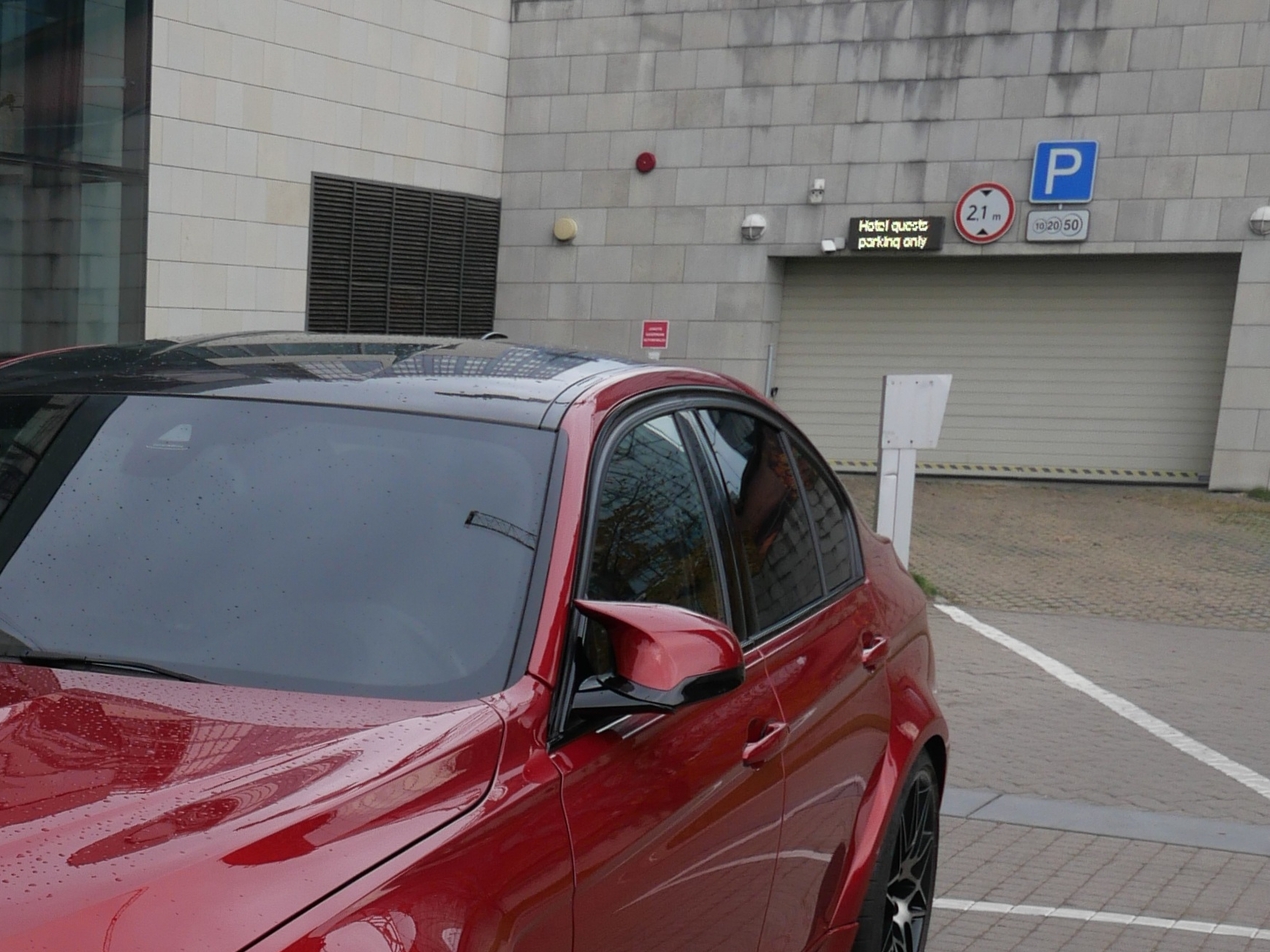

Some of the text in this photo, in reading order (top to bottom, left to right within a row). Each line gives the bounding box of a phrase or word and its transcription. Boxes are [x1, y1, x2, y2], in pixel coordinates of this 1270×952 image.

[1045, 148, 1082, 195] P
[992, 213, 1001, 221] m
[858, 219, 889, 232] Hotel
[1035, 219, 1079, 231] 10 20 50
[858, 235, 928, 250] parking only
